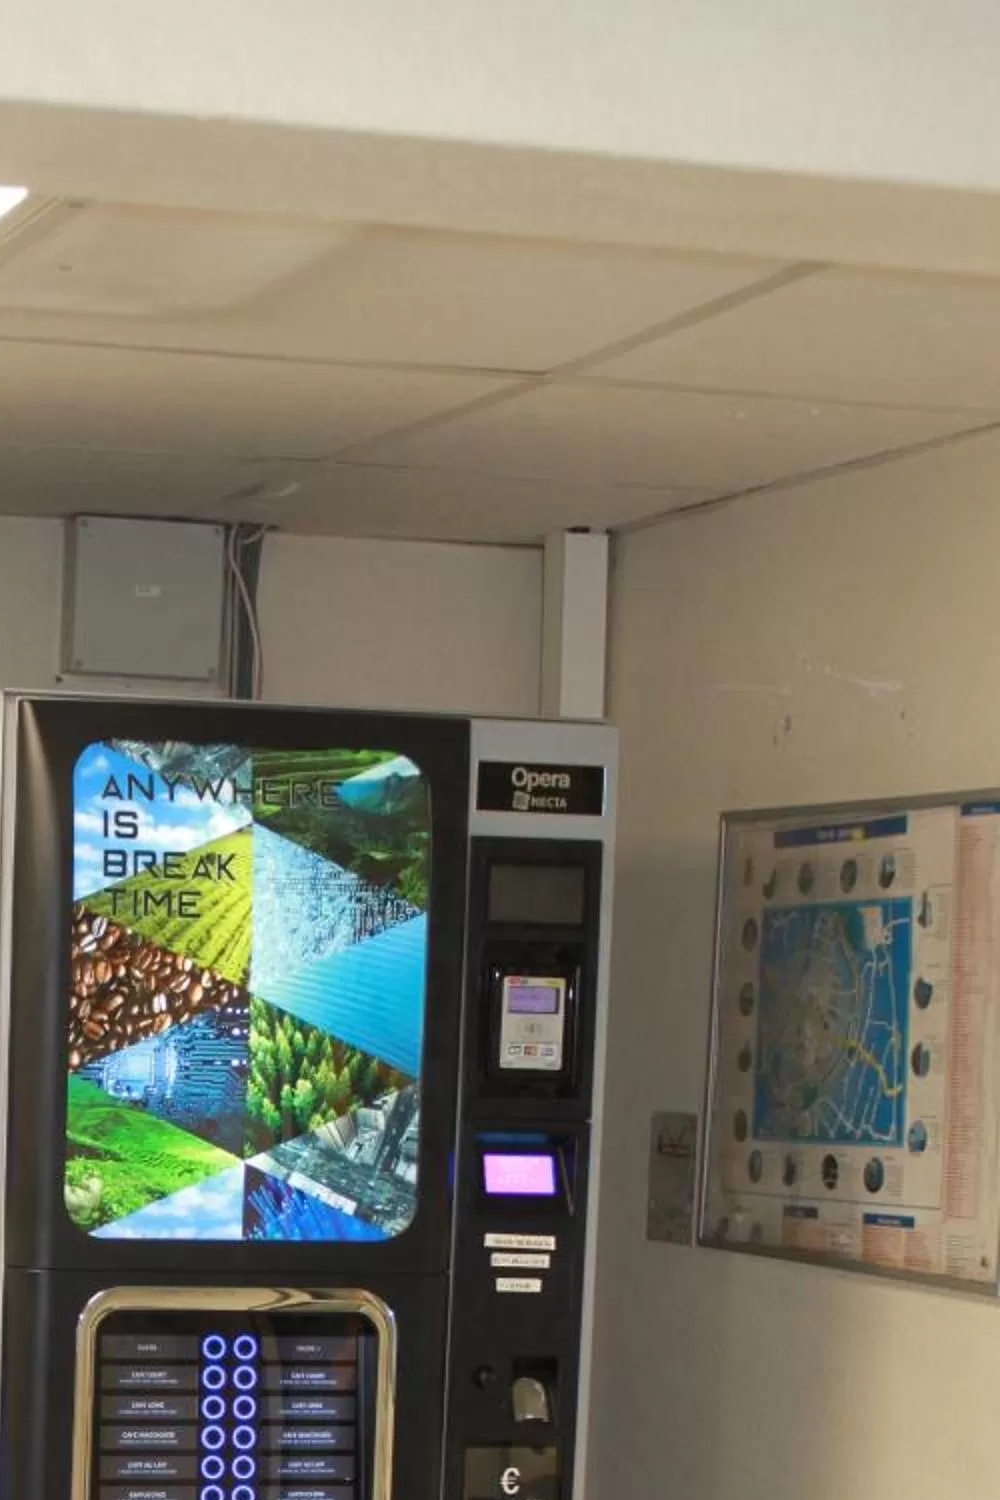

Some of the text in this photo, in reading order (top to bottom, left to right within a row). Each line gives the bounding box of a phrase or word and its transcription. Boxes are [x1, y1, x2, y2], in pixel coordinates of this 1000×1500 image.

[101, 773, 343, 808] ANYWHERE
[512, 767, 571, 792] Opera
[103, 810, 139, 839] IS
[103, 851, 236, 881] BREAK
[104, 888, 202, 919] TIME
[500, 1467, 521, 1494] €
